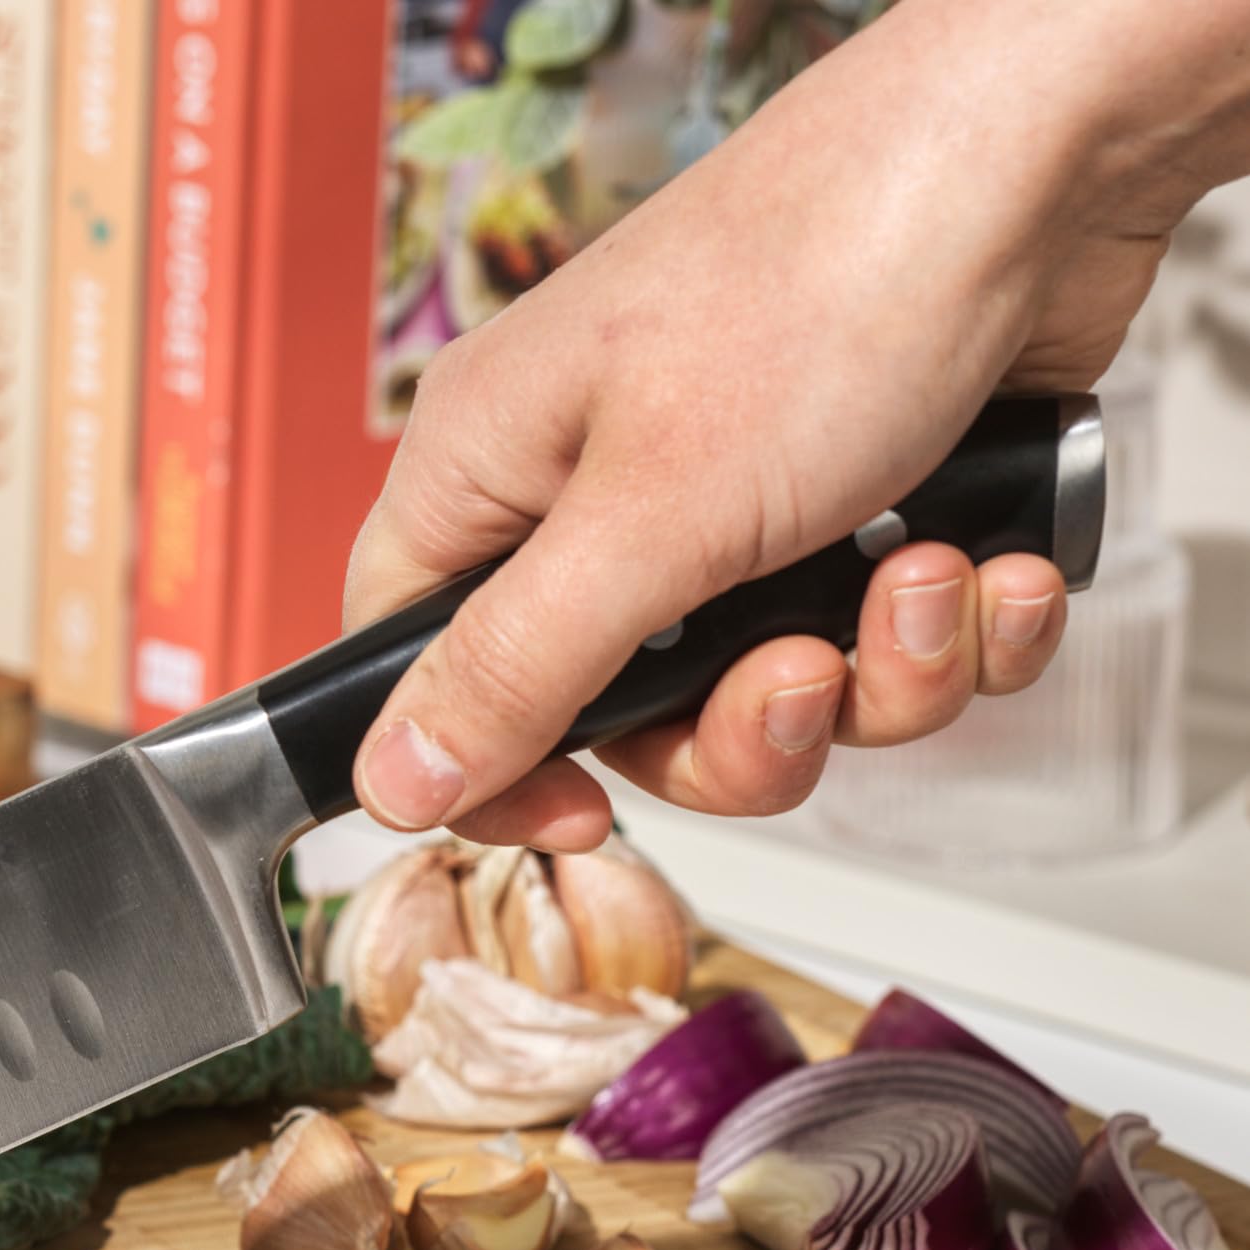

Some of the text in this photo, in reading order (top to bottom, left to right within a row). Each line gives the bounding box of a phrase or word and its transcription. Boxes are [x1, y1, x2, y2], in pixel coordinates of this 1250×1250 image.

[173, 31, 218, 126] ON
[168, 126, 213, 176] A
[160, 180, 213, 405] BUDGET
